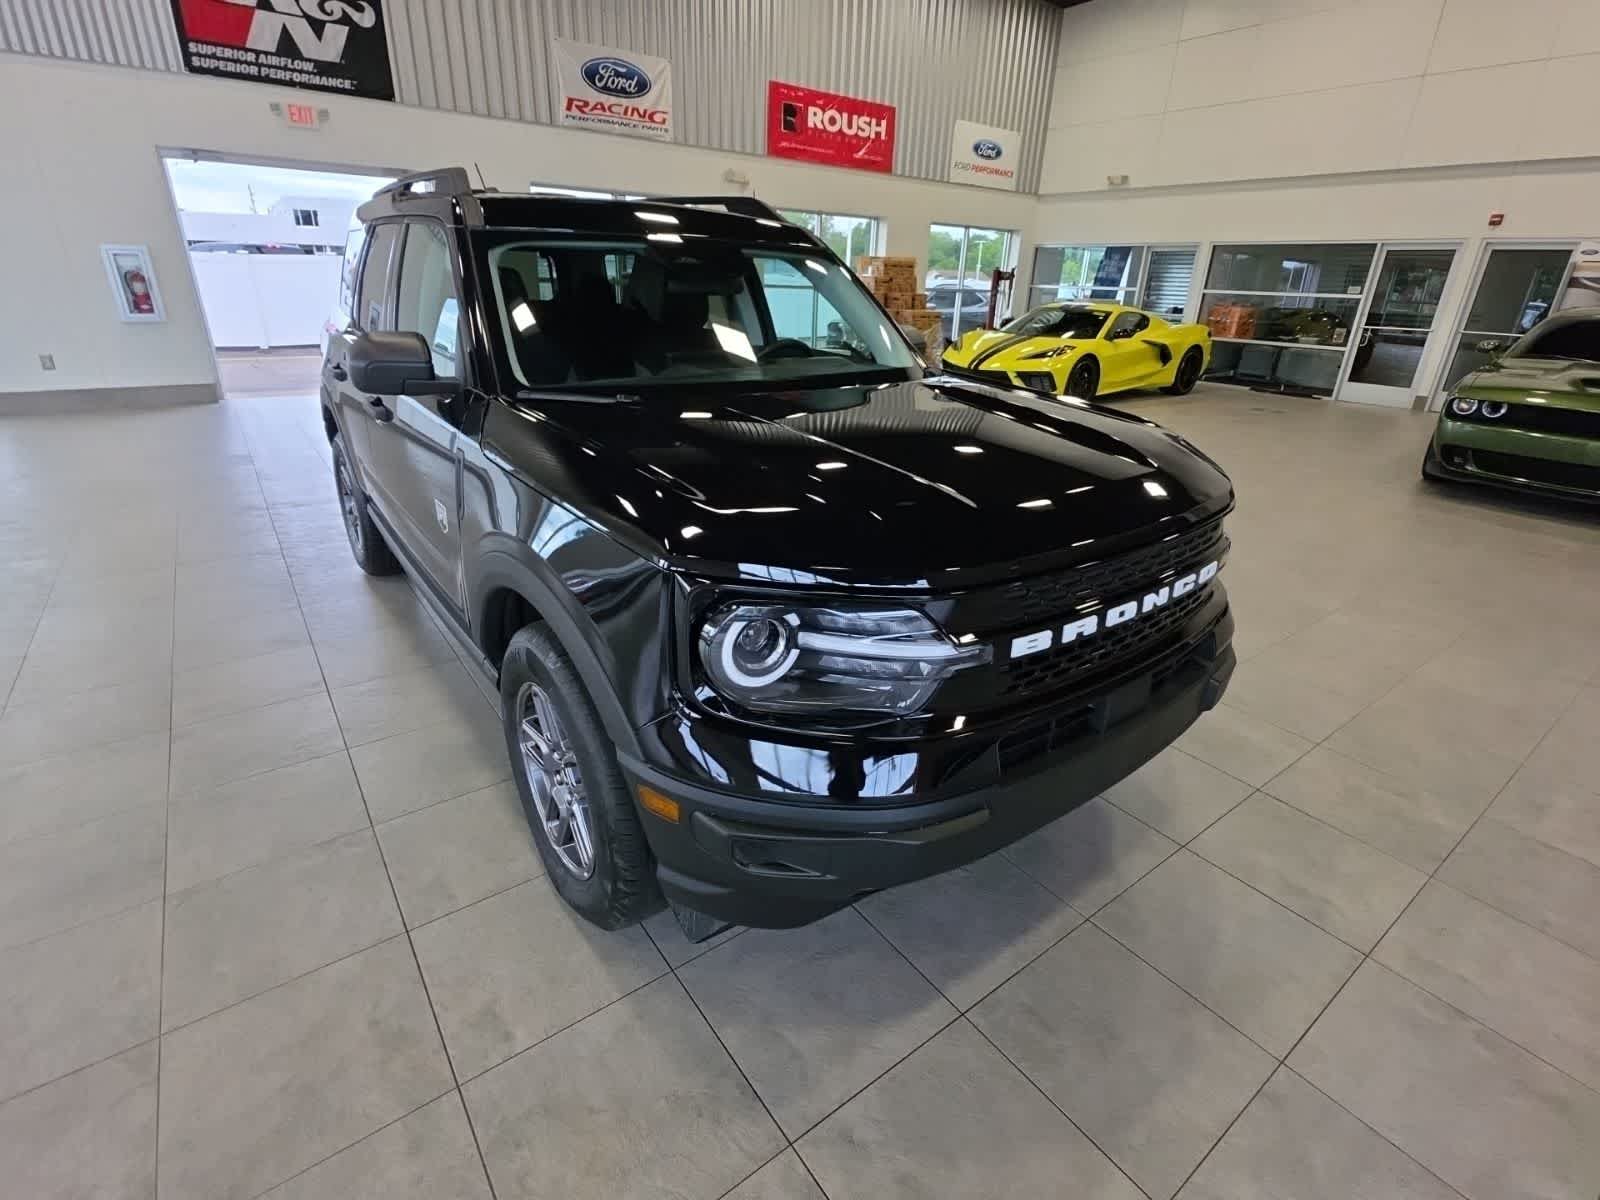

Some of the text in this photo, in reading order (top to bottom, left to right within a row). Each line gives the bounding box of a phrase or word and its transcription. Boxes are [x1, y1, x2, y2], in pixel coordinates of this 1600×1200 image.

[188, 41, 318, 73] SUPERIOR AIRFLOW.
[191, 56, 259, 77] SUPERIOR
[594, 63, 639, 93] Ford
[287, 103, 314, 125] EXIT
[564, 96, 669, 125] RACING
[807, 105, 888, 141] ROUSH
[565, 113, 670, 134] PERFORMANCE PARTS
[977, 143, 998, 158] Ford
[971, 163, 1014, 178] PERFORMANCE
[1010, 561, 1219, 659] BRONCO
